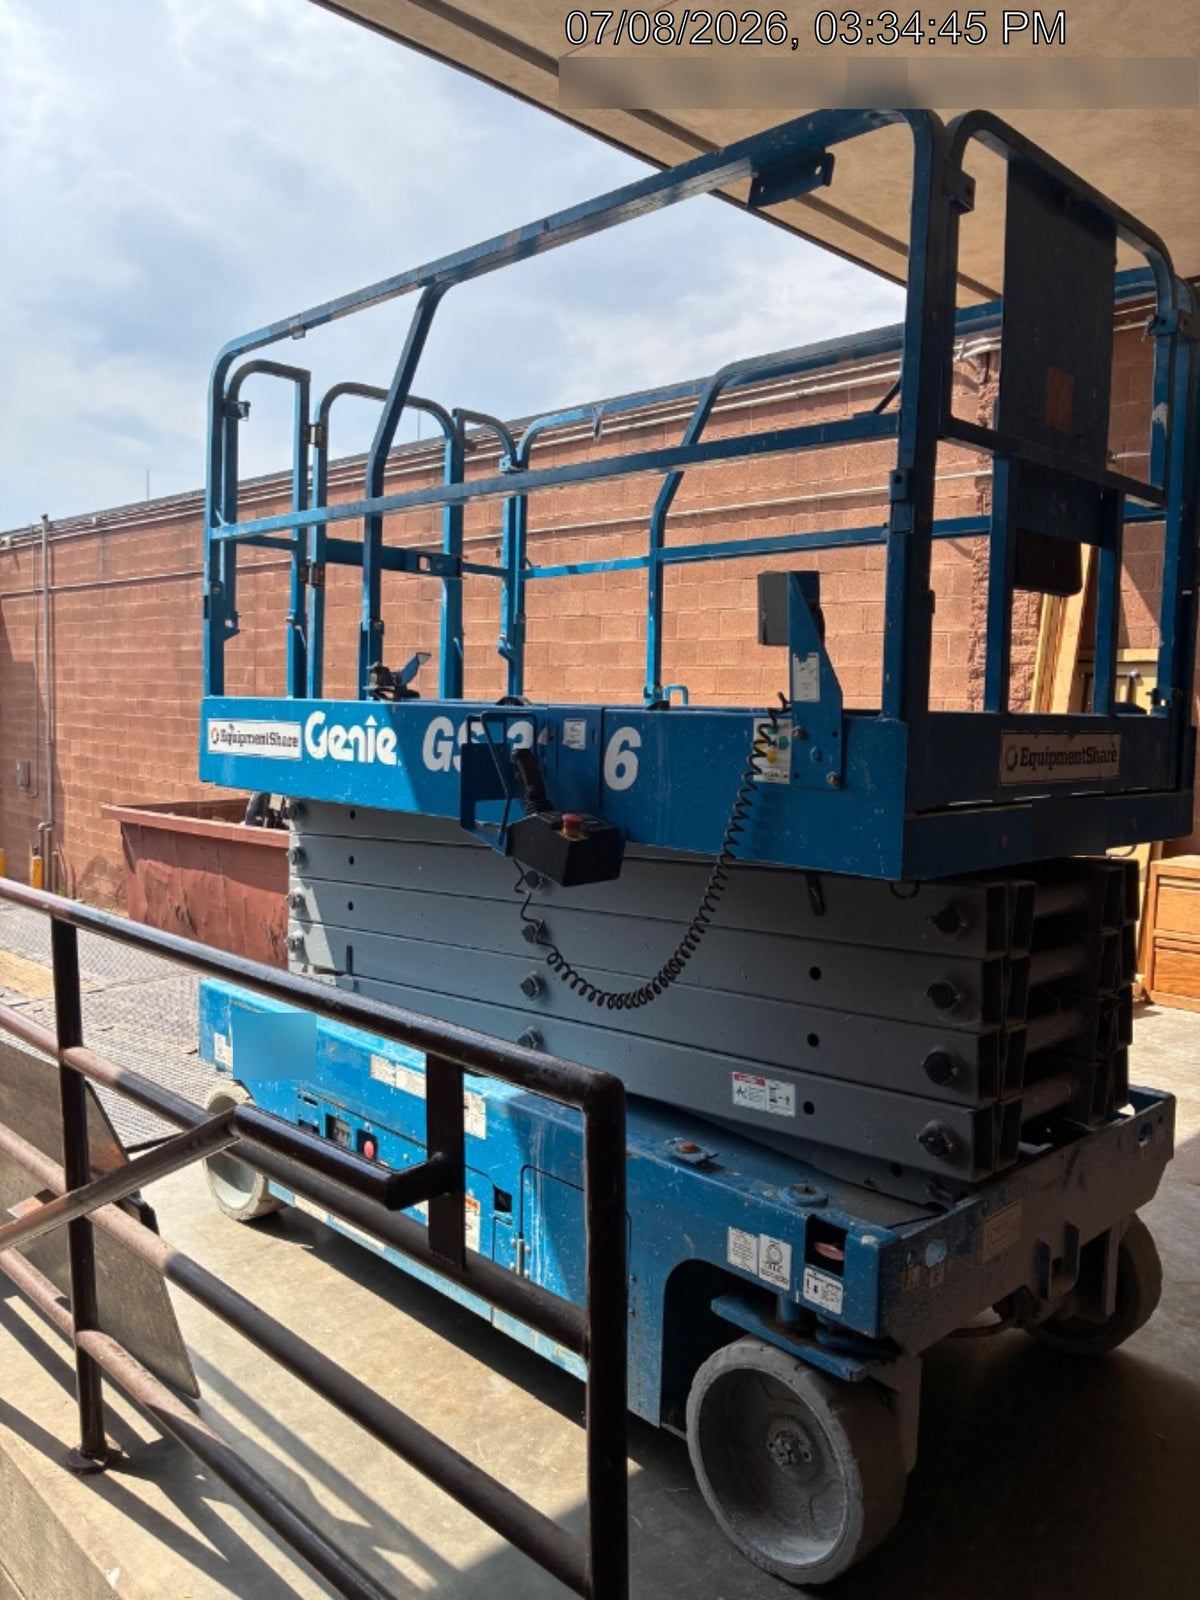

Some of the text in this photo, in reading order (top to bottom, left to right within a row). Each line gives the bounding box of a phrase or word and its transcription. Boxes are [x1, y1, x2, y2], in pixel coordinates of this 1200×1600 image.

[219, 727, 299, 749] EquipmentShare
[304, 710, 398, 766] Genie
[1020, 746, 1118, 771] EquipmentShare
